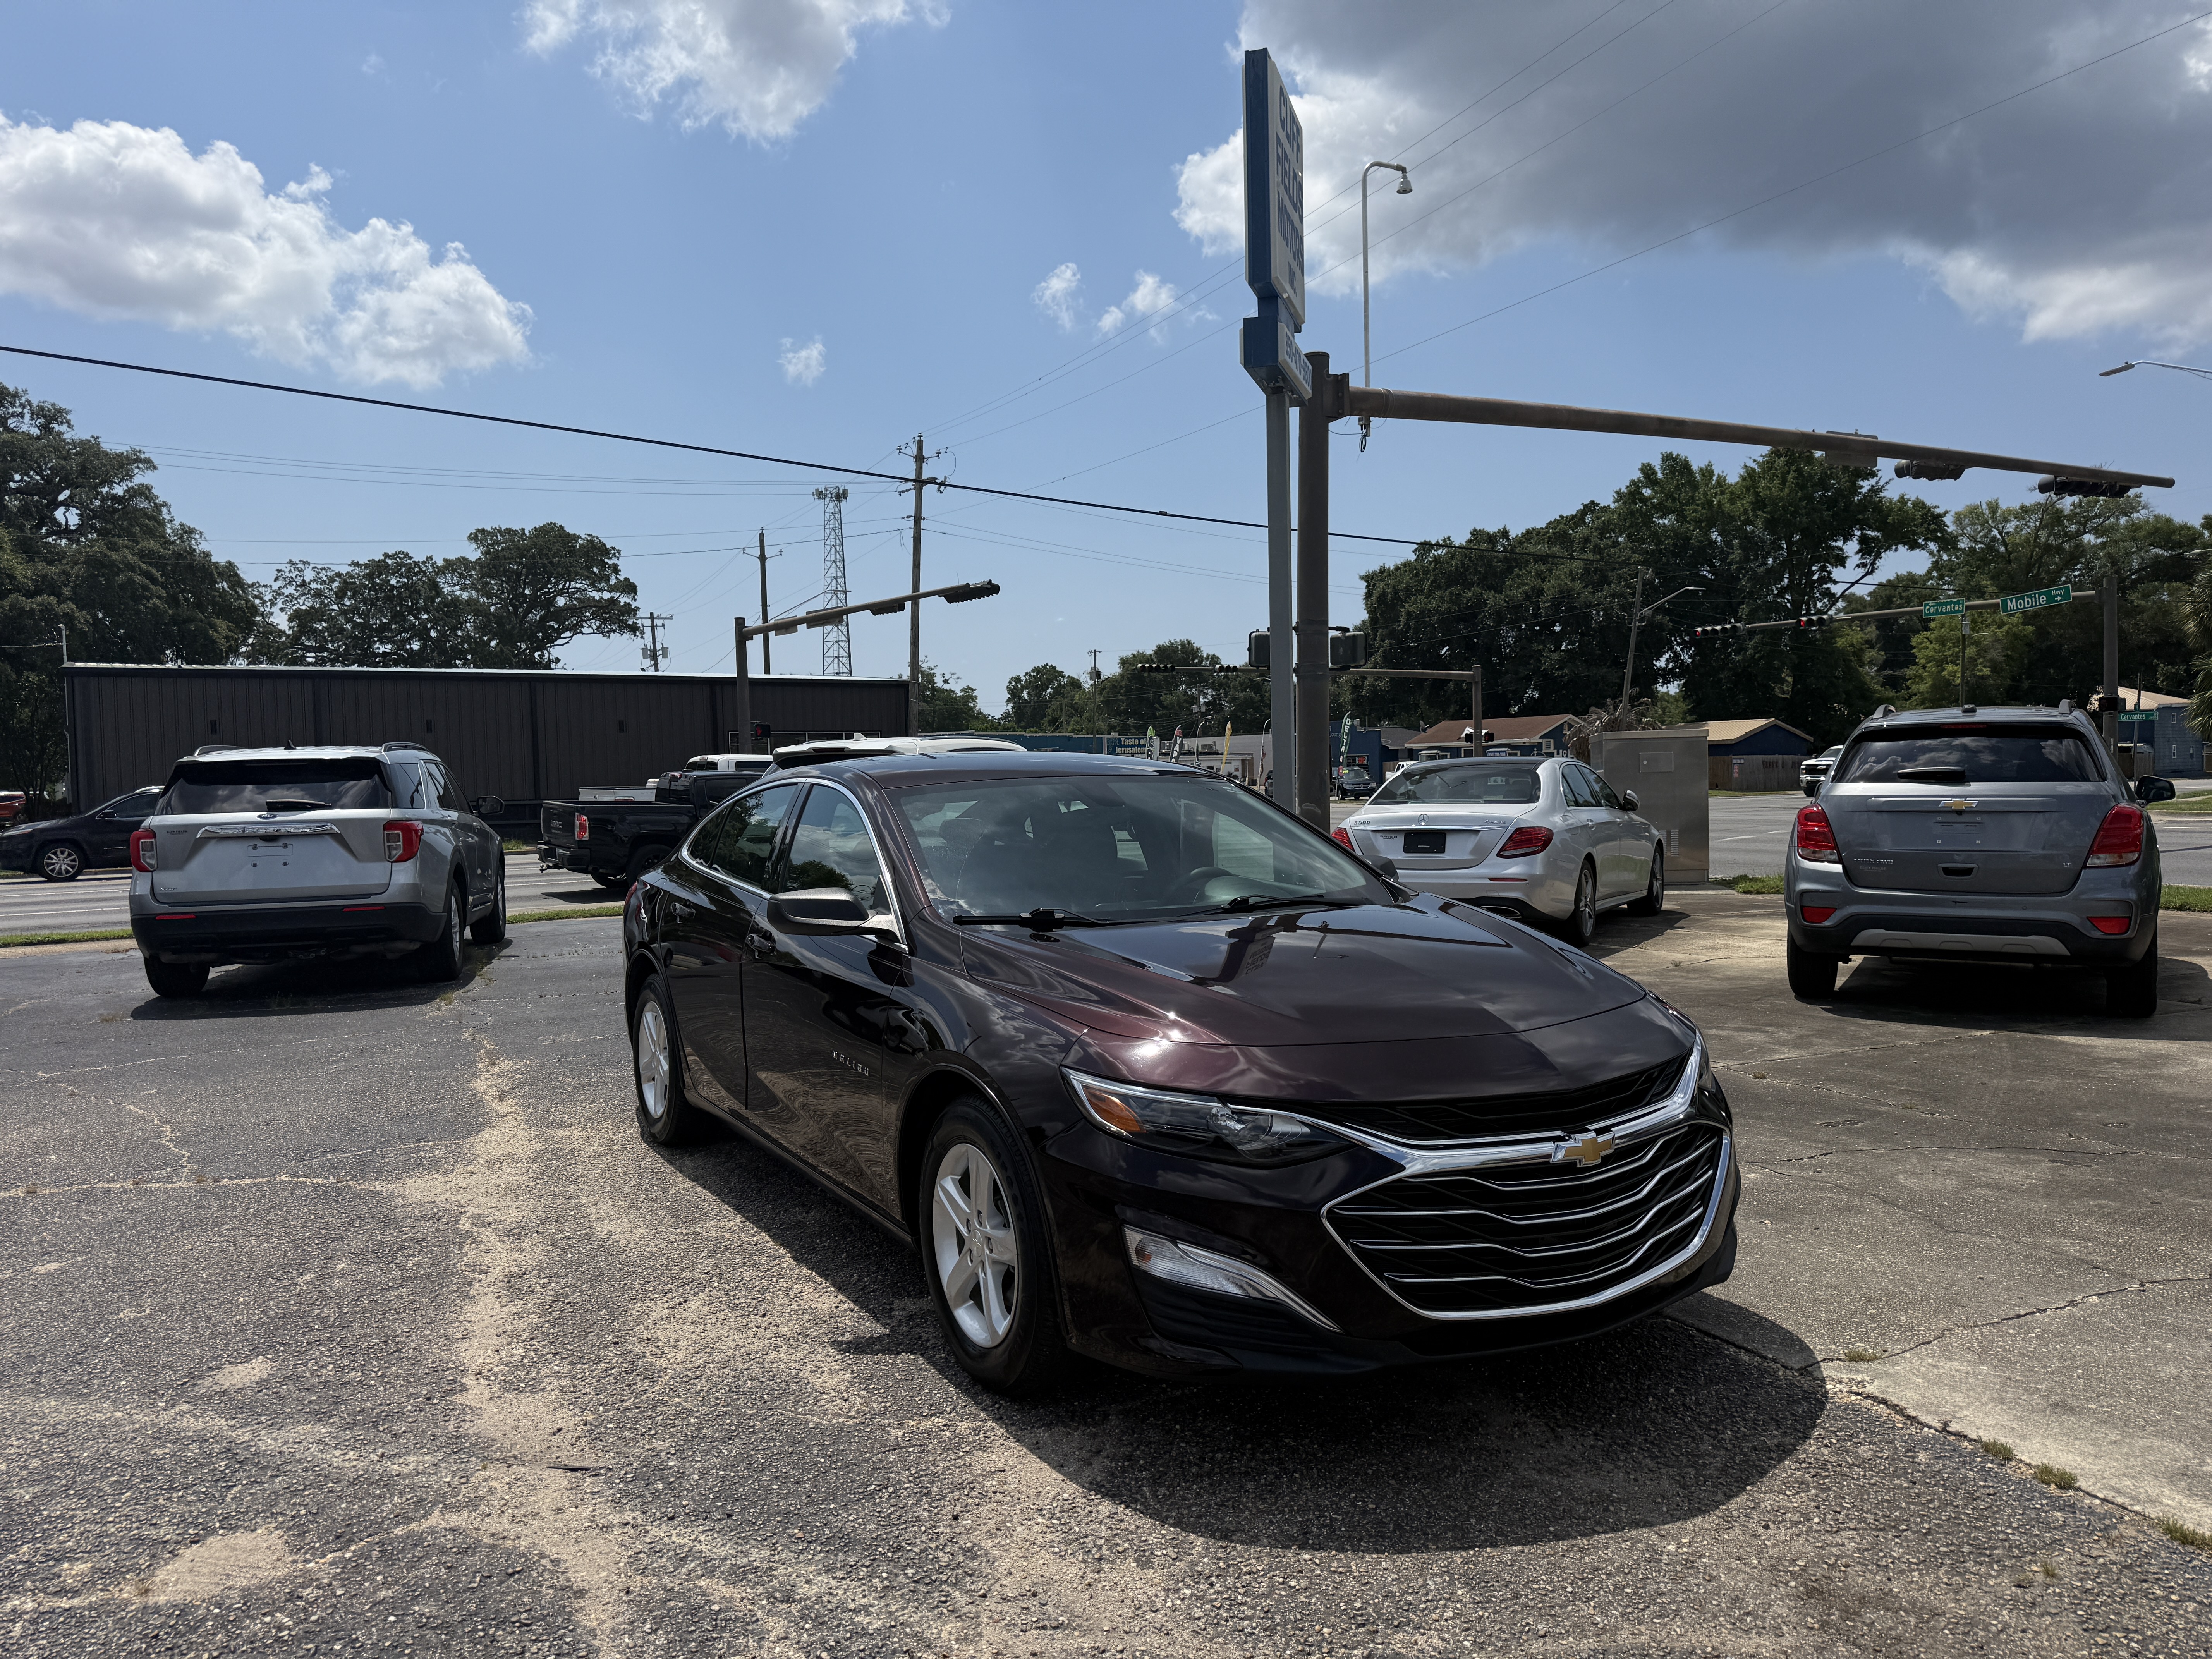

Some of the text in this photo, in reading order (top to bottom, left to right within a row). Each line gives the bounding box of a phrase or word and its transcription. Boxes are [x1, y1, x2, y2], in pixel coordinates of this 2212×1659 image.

[1279, 85, 1300, 163] CLIFF
[1276, 131, 1304, 224] FIELDS
[1278, 190, 1304, 277] MOTORS
[1925, 604, 1962, 613] Cervantes
[2007, 594, 2046, 611] Mobile
[833, 1050, 869, 1076] MALIBU
